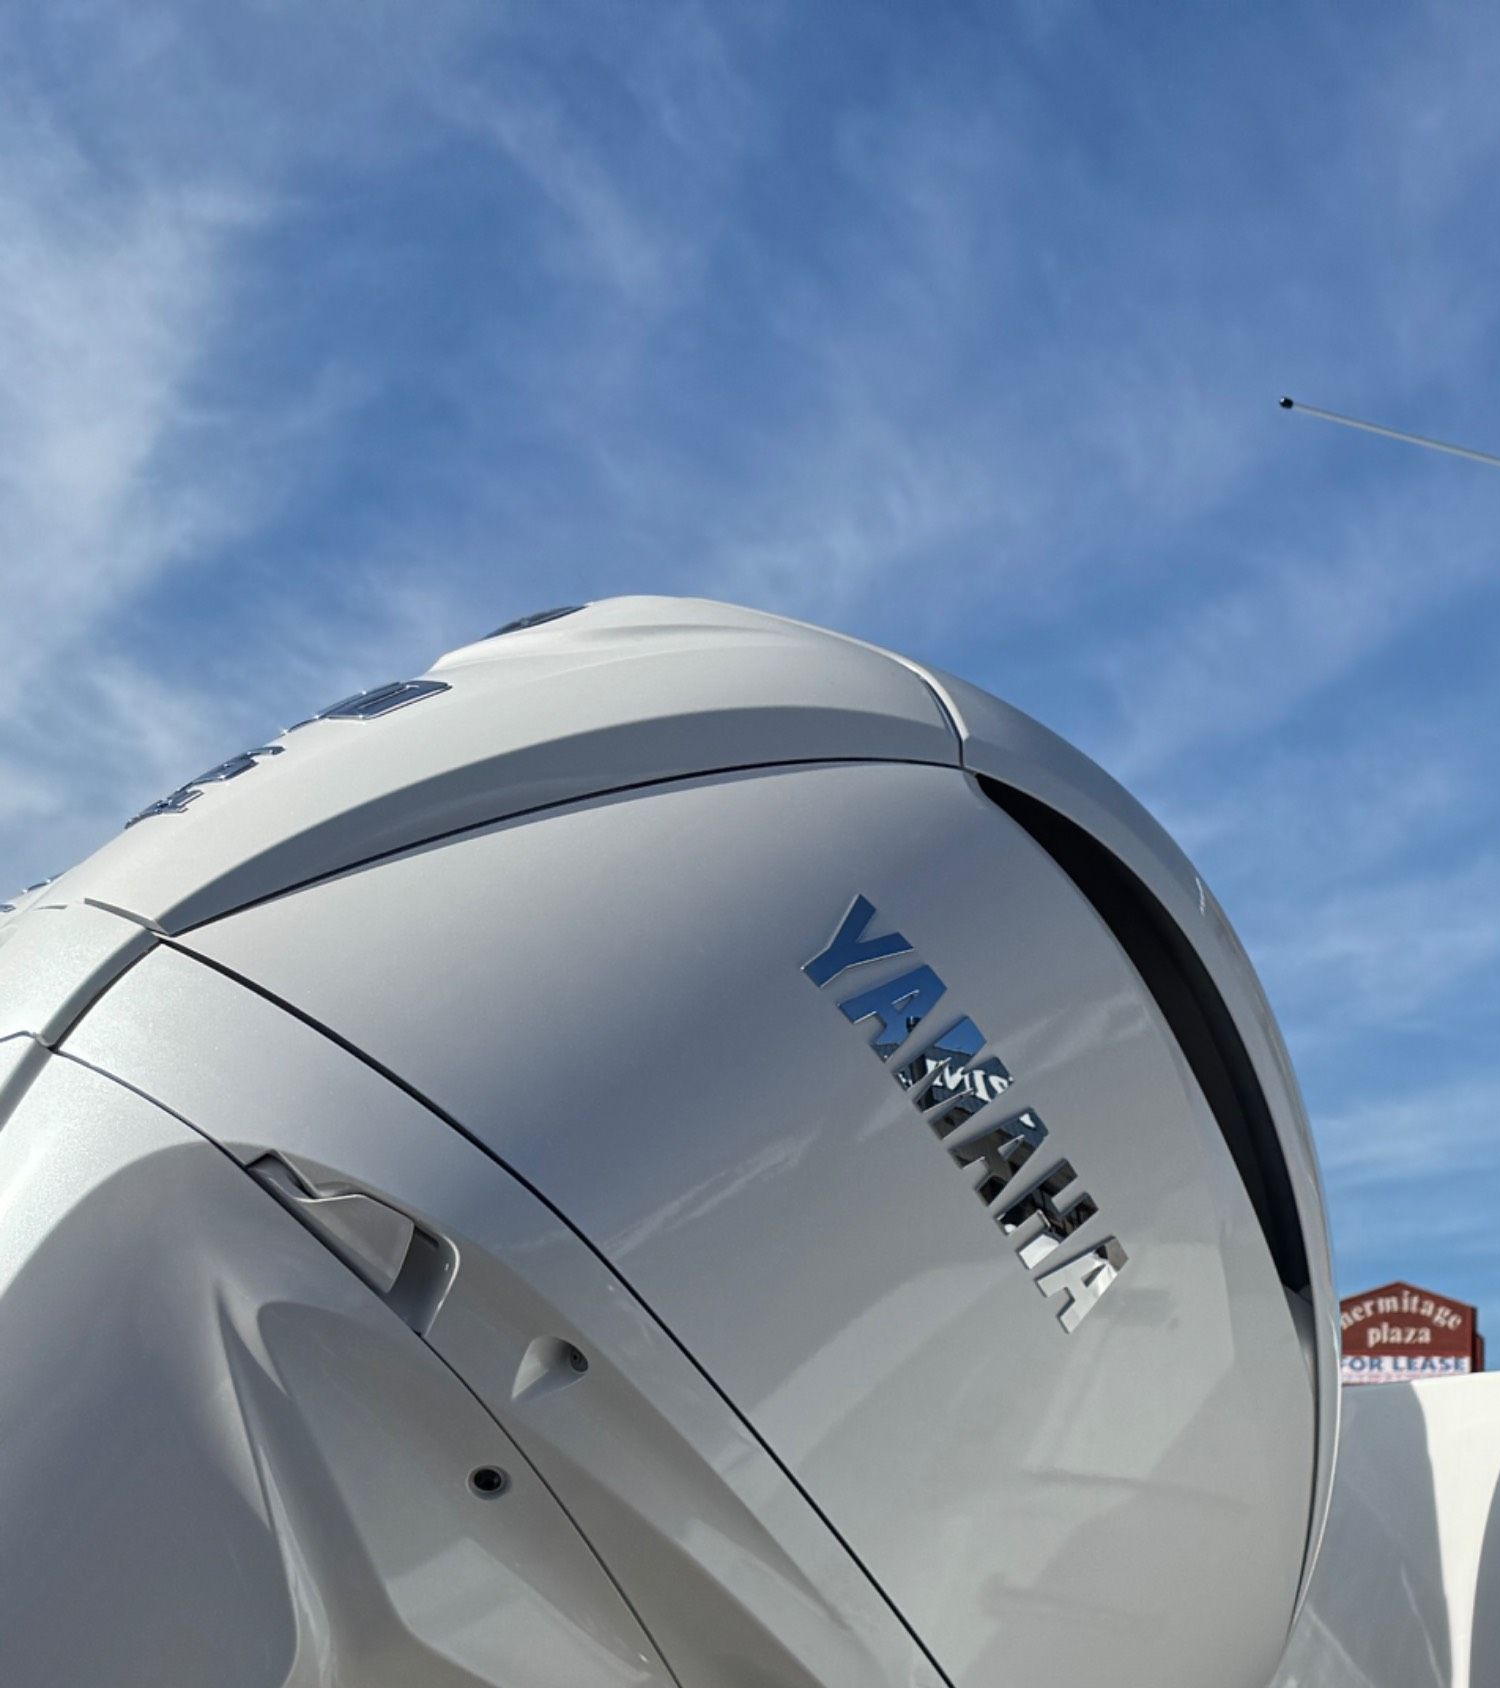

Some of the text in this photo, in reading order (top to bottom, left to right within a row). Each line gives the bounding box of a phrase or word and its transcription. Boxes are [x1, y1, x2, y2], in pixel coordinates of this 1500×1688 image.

[800, 894, 1129, 1334] YAMAHA
[1367, 1321, 1432, 1348] plaza
[1393, 1355, 1466, 1371] LEASE
